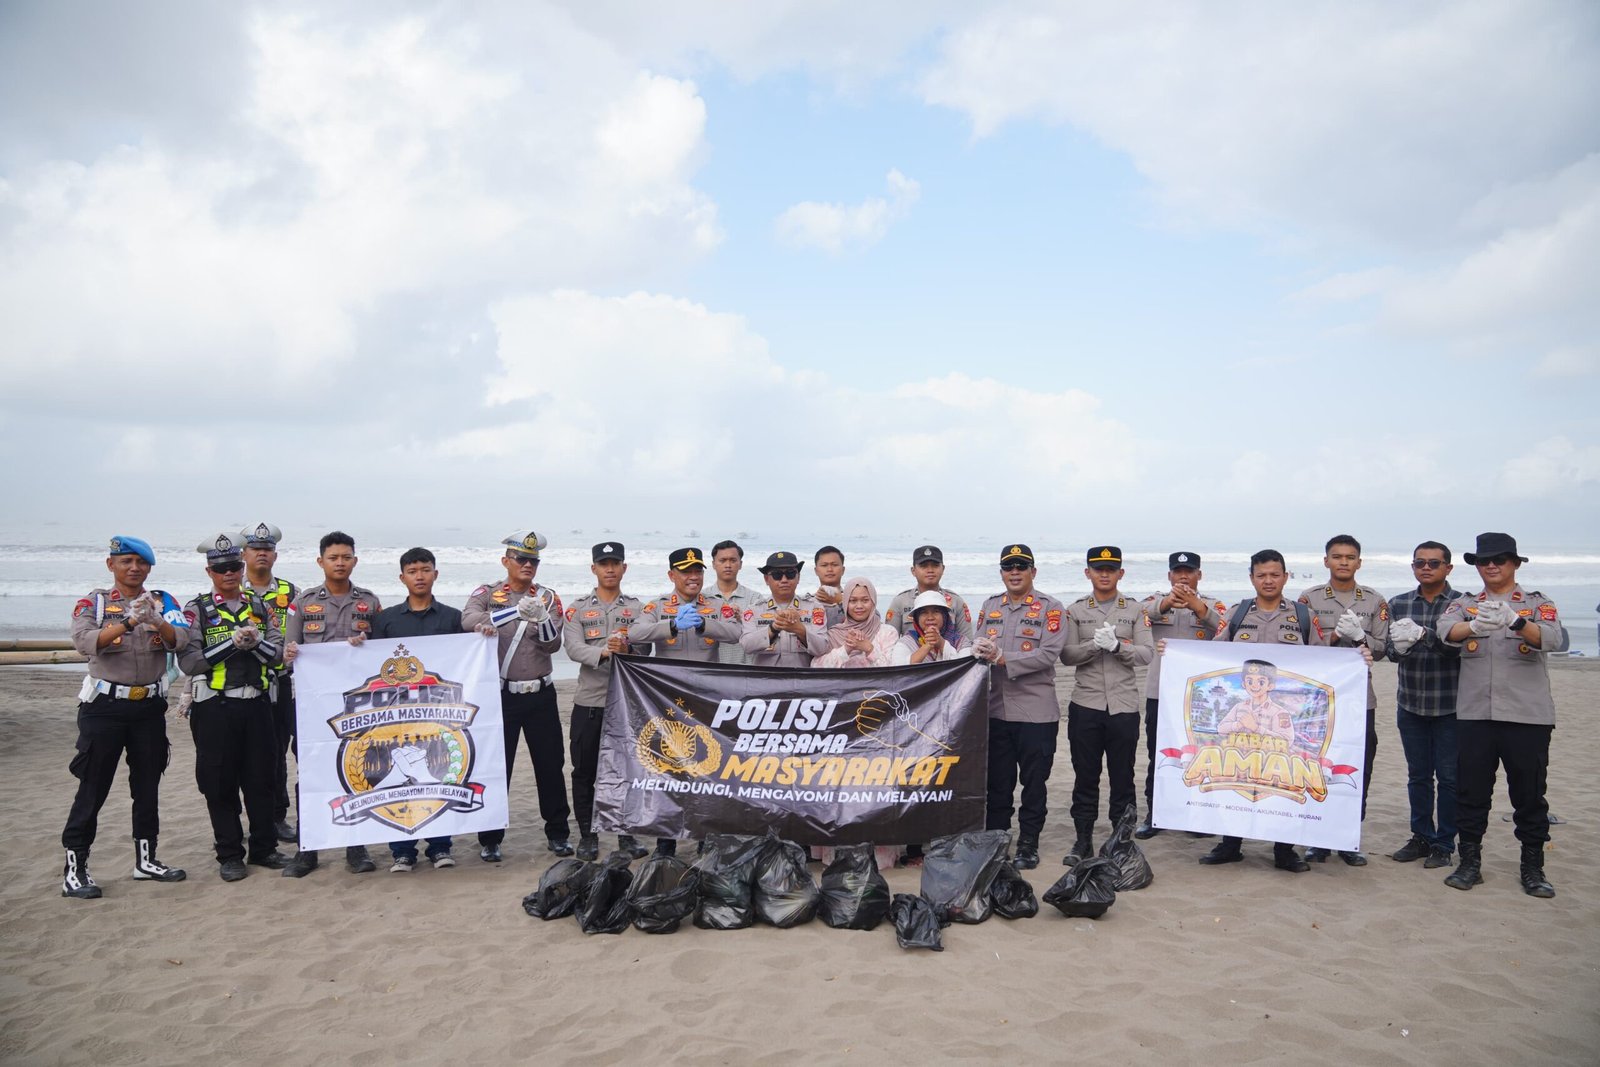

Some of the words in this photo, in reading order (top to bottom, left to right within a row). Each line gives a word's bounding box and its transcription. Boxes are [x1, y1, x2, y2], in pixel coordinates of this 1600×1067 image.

[346, 684, 464, 713] POLISI
[342, 711, 394, 731] BERSAMA
[399, 707, 468, 720] MASYARAKAT
[711, 699, 839, 731] POLISI
[733, 733, 848, 753] BERSAMA
[1222, 732, 1288, 752] JABAR
[720, 756, 960, 786] MASYARAKAT
[1183, 746, 1328, 802] AMAN
[388, 788, 425, 799] MENGAYOMI
[426, 788, 438, 796] DAN
[440, 788, 468, 799] MELAYANI
[632, 777, 733, 798] MELINDUNGI,
[738, 786, 834, 803] MENGAYOMI
[838, 789, 872, 803] DAN
[876, 789, 952, 803] MELAYANI
[1225, 805, 1253, 813] MODERN
